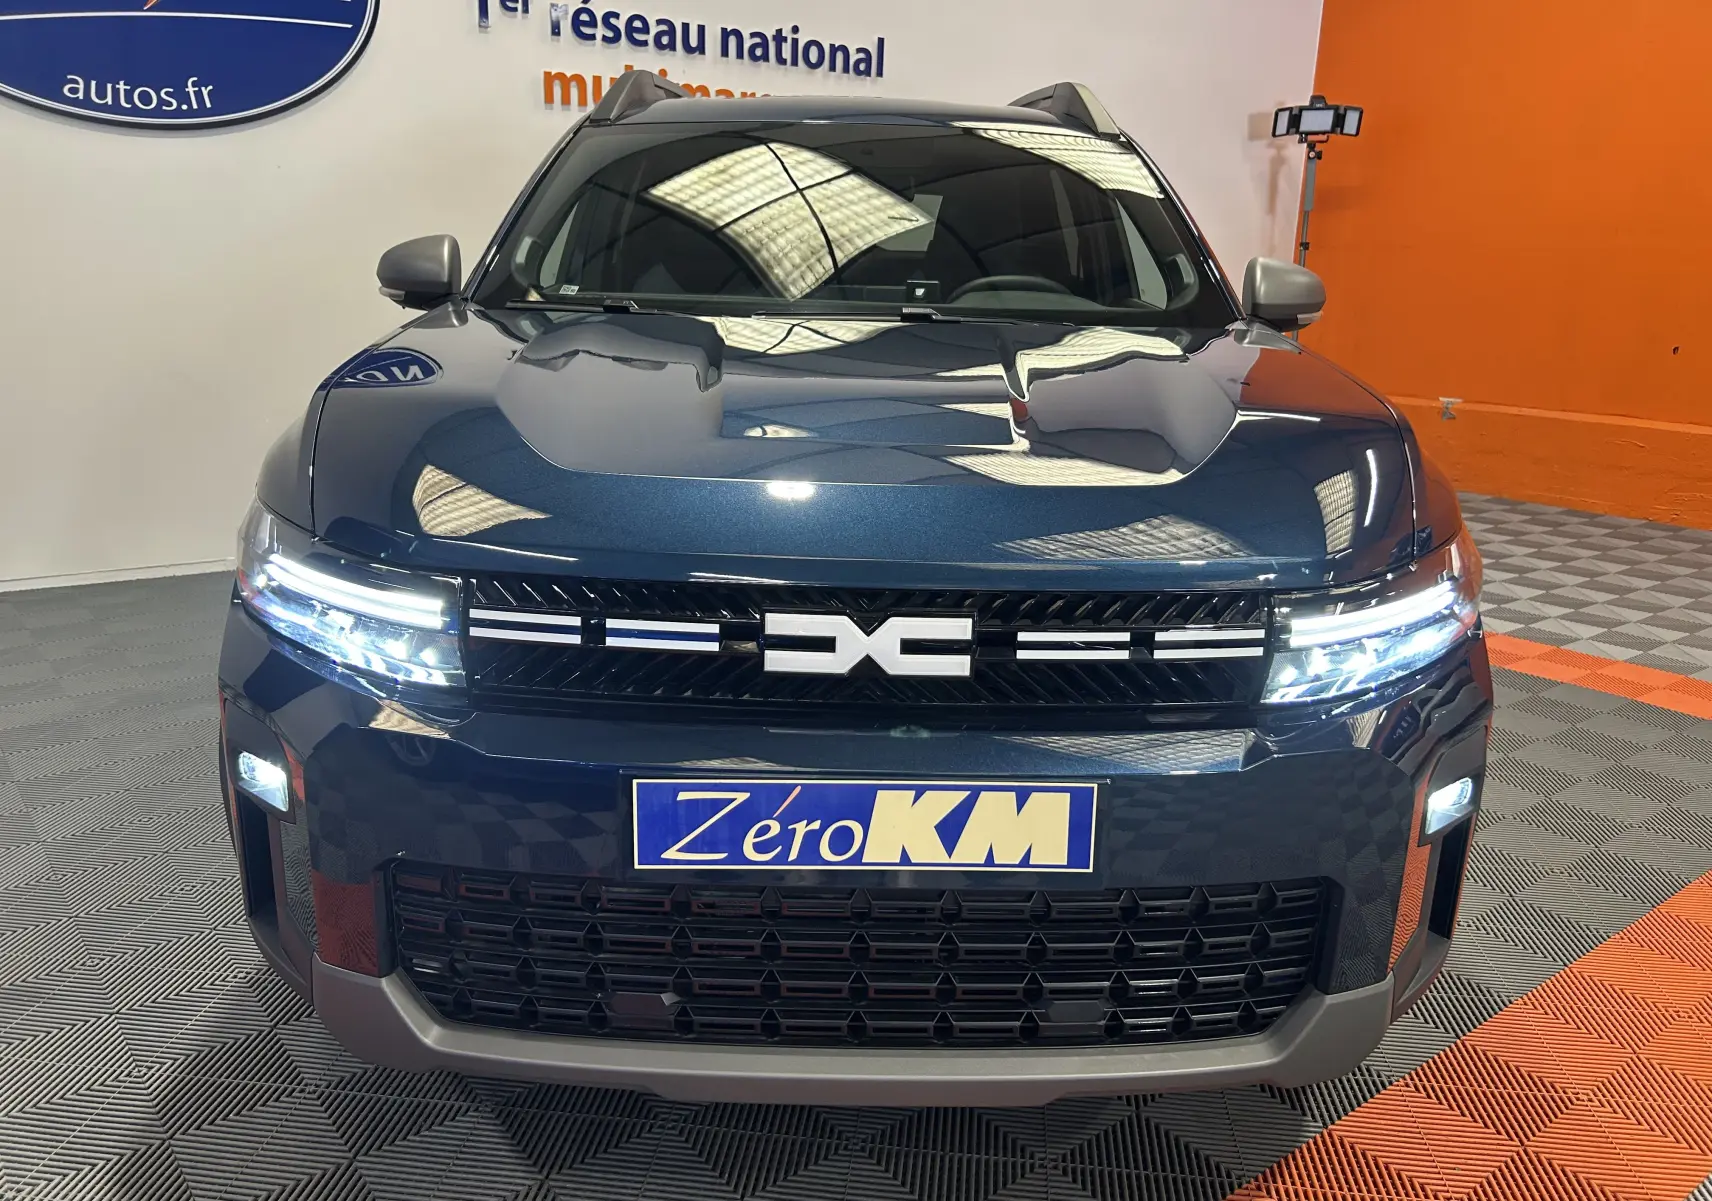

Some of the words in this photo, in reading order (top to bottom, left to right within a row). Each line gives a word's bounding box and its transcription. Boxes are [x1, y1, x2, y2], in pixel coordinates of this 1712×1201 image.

[550, 0, 706, 55] réseau
[720, 25, 885, 78] national
[63, 75, 213, 110] autos.fr
